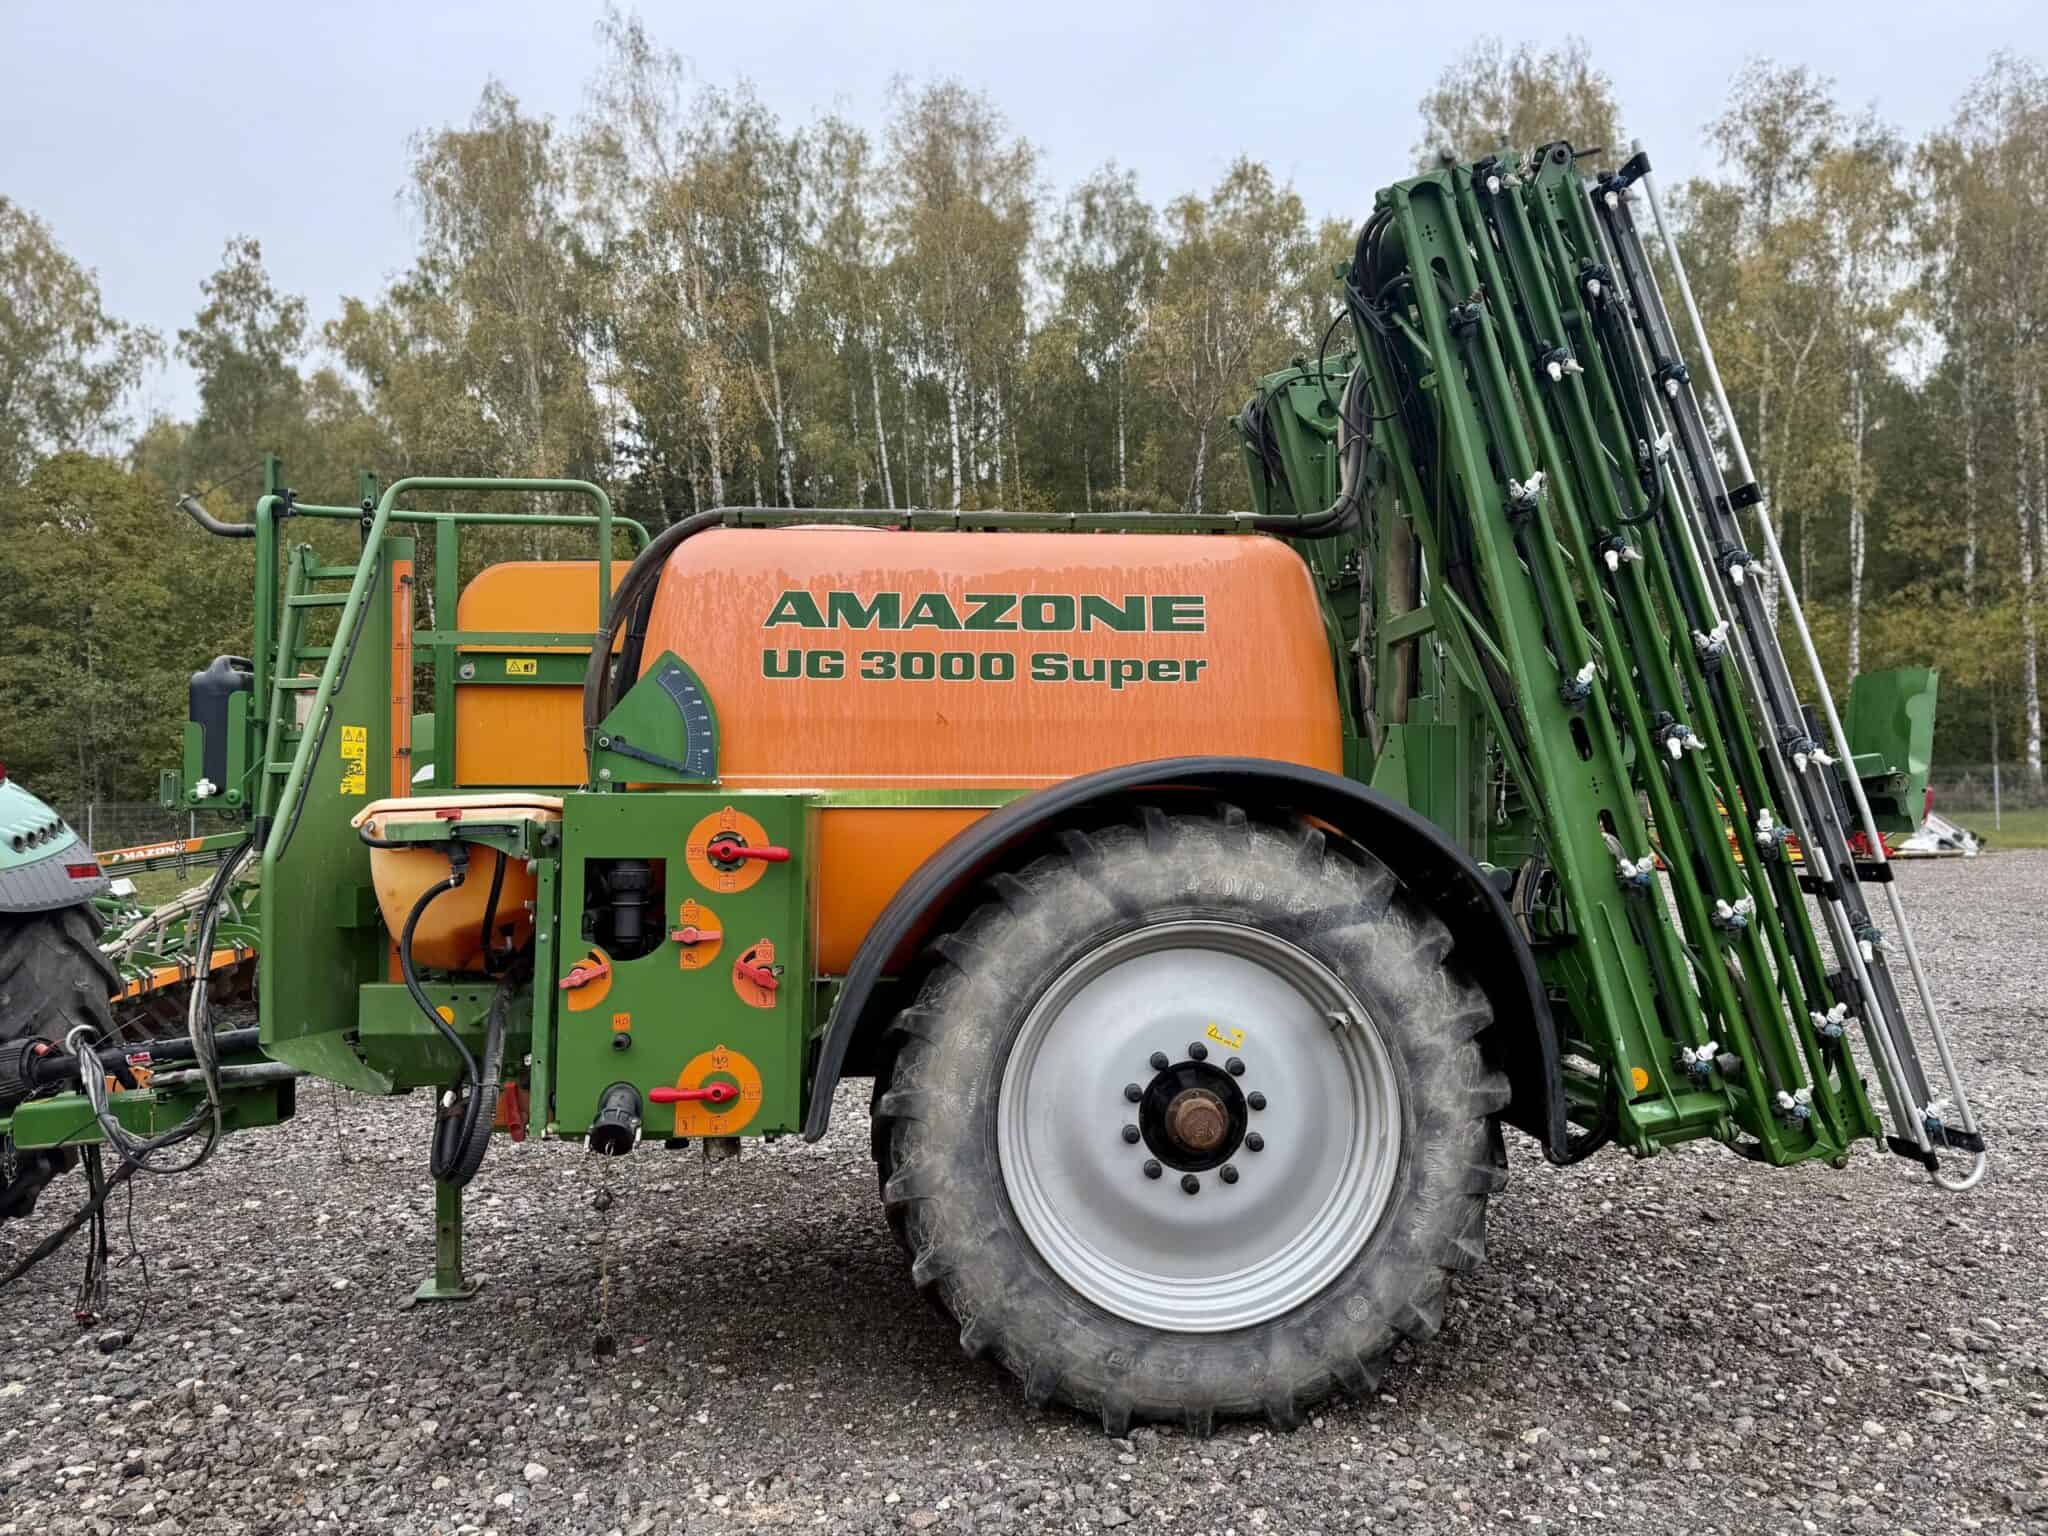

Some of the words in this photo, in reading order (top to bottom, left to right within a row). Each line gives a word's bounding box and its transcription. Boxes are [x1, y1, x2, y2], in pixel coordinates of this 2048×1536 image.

[763, 590, 1206, 632] AMAZONE
[762, 649, 844, 679] UG
[860, 651, 1015, 681] 3000
[1031, 652, 1207, 690] Super
